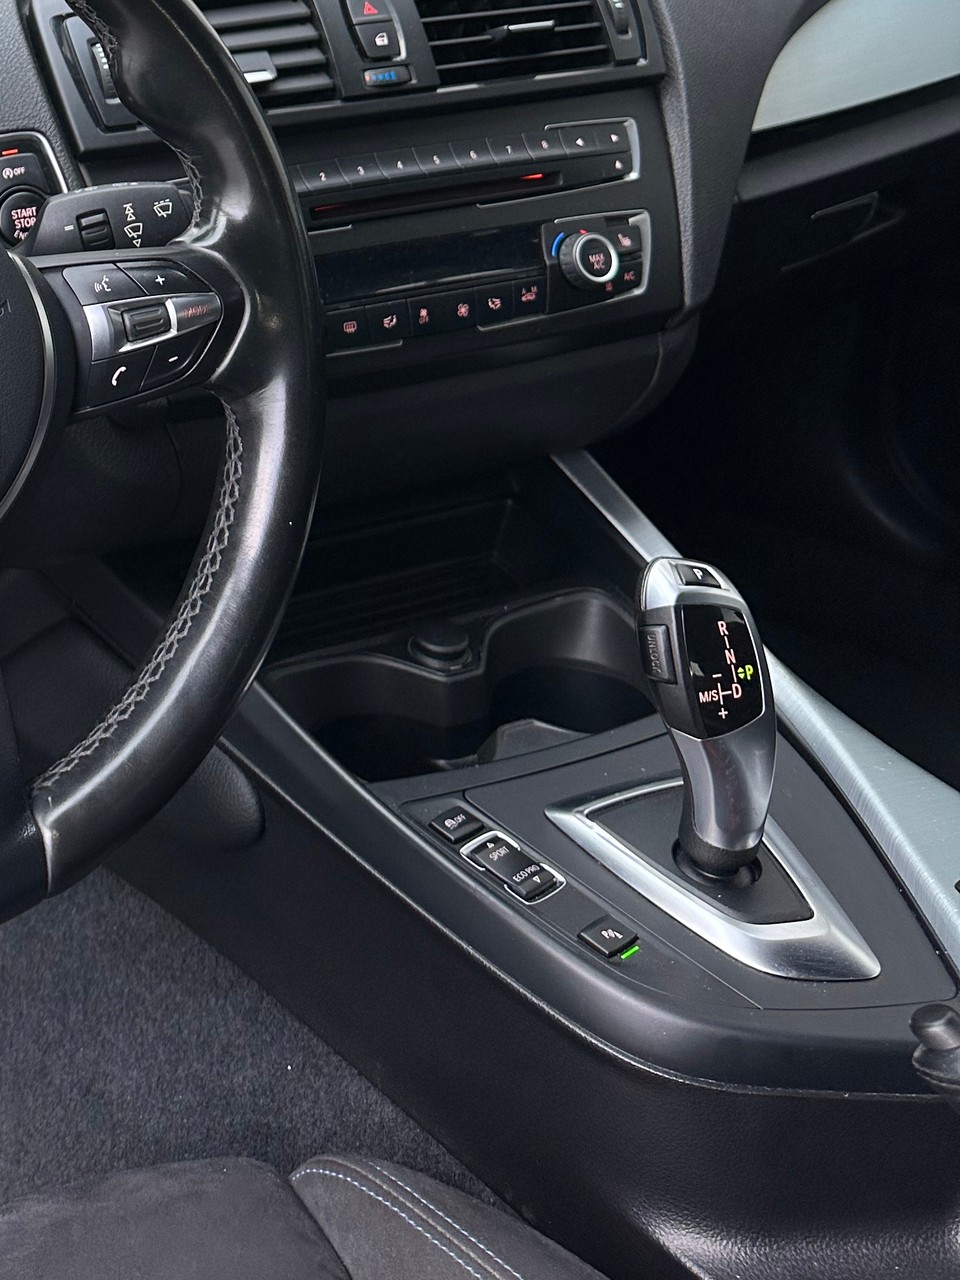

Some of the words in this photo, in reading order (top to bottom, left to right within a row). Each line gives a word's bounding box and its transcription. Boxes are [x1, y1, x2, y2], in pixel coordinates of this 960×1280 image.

[319, 171, 327, 181] 2
[357, 165, 365, 176] 3
[396, 159, 404, 170] 4
[433, 154, 440, 165] 5
[470, 149, 477, 160] 6
[505, 145, 512, 155] 7
[13, 166, 26, 176] OFF
[11, 206, 37, 220] START
[14, 216, 37, 230] STOP
[589, 252, 605, 263] MAX
[593, 260, 606, 270] A/C
[623, 270, 636, 281] A/C
[692, 568, 704, 580] P
[717, 621, 729, 636] R
[647, 634, 662, 673] UNLOCK
[725, 649, 737, 665] N
[745, 664, 754, 681] P
[698, 689, 719, 704] M/S
[731, 683, 742, 699] D
[489, 845, 510, 861] SPORT
[512, 869, 529, 883] ECO
[526, 864, 540, 875] PRO
